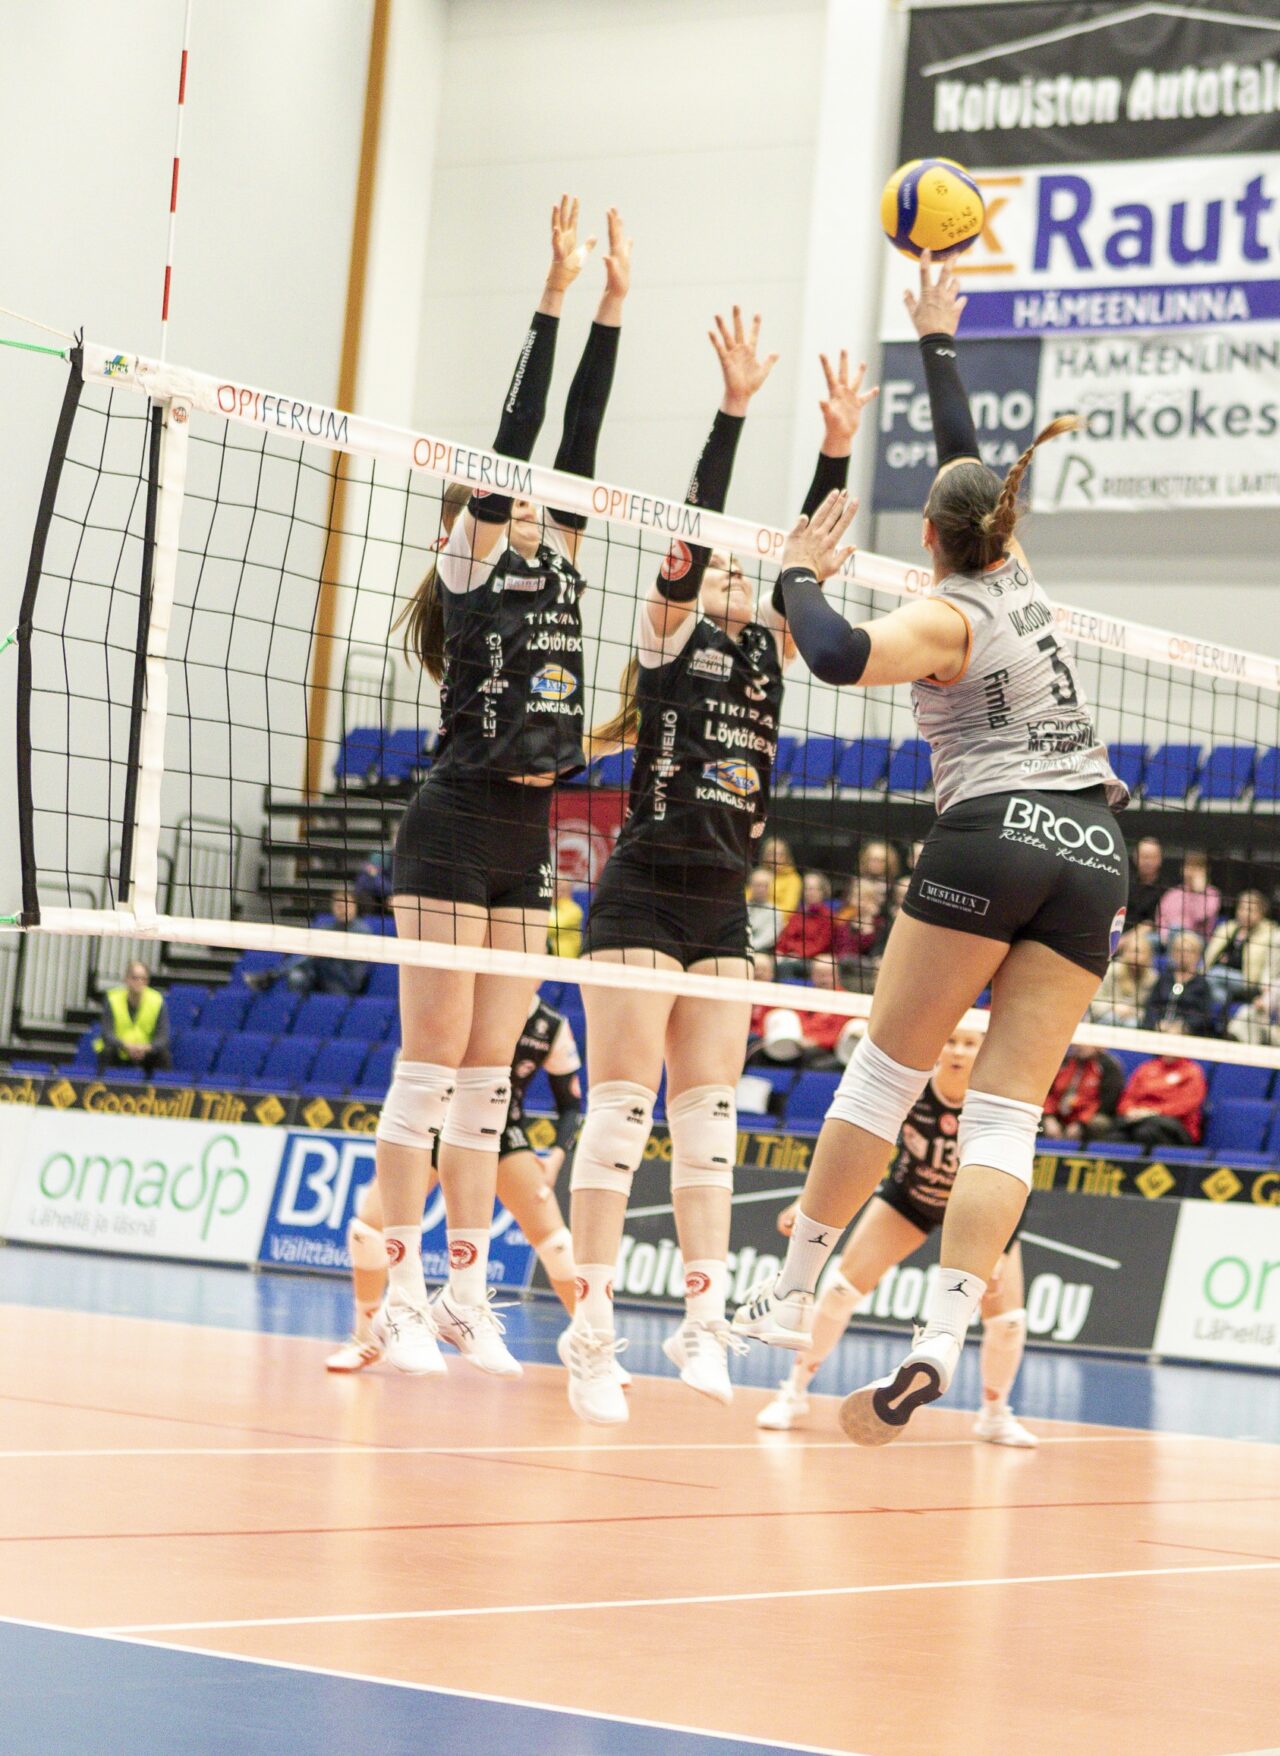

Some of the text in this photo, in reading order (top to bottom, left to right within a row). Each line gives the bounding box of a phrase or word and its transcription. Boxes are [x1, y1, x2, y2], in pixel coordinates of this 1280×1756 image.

[935, 76, 1121, 132] Koiviston
[1014, 288, 1249, 328] HÄMEENLINNA
[217, 385, 348, 443] OPIFERUM
[882, 380, 1032, 433] Feno
[413, 437, 532, 495] OPIFERUM
[592, 485, 701, 538] OPIFERUM
[1056, 606, 1126, 649] PIFERUM
[1168, 637, 1246, 677] OPIFERUM
[654, 709, 678, 821] LEVY NELIÖ
[1003, 797, 1114, 856] BROO
[1056, 848, 1120, 876] Koskinen
[927, 885, 977, 908] MUSTALUX
[83, 1082, 247, 1124] Goodwill Tilit
[755, 1136, 810, 1170] Tilit
[932, 1137, 960, 1174] 13
[1064, 1159, 1126, 1198] Tilit
[1025, 1273, 1094, 1342] Oy
[1195, 1318, 1276, 1345] Lähellä
